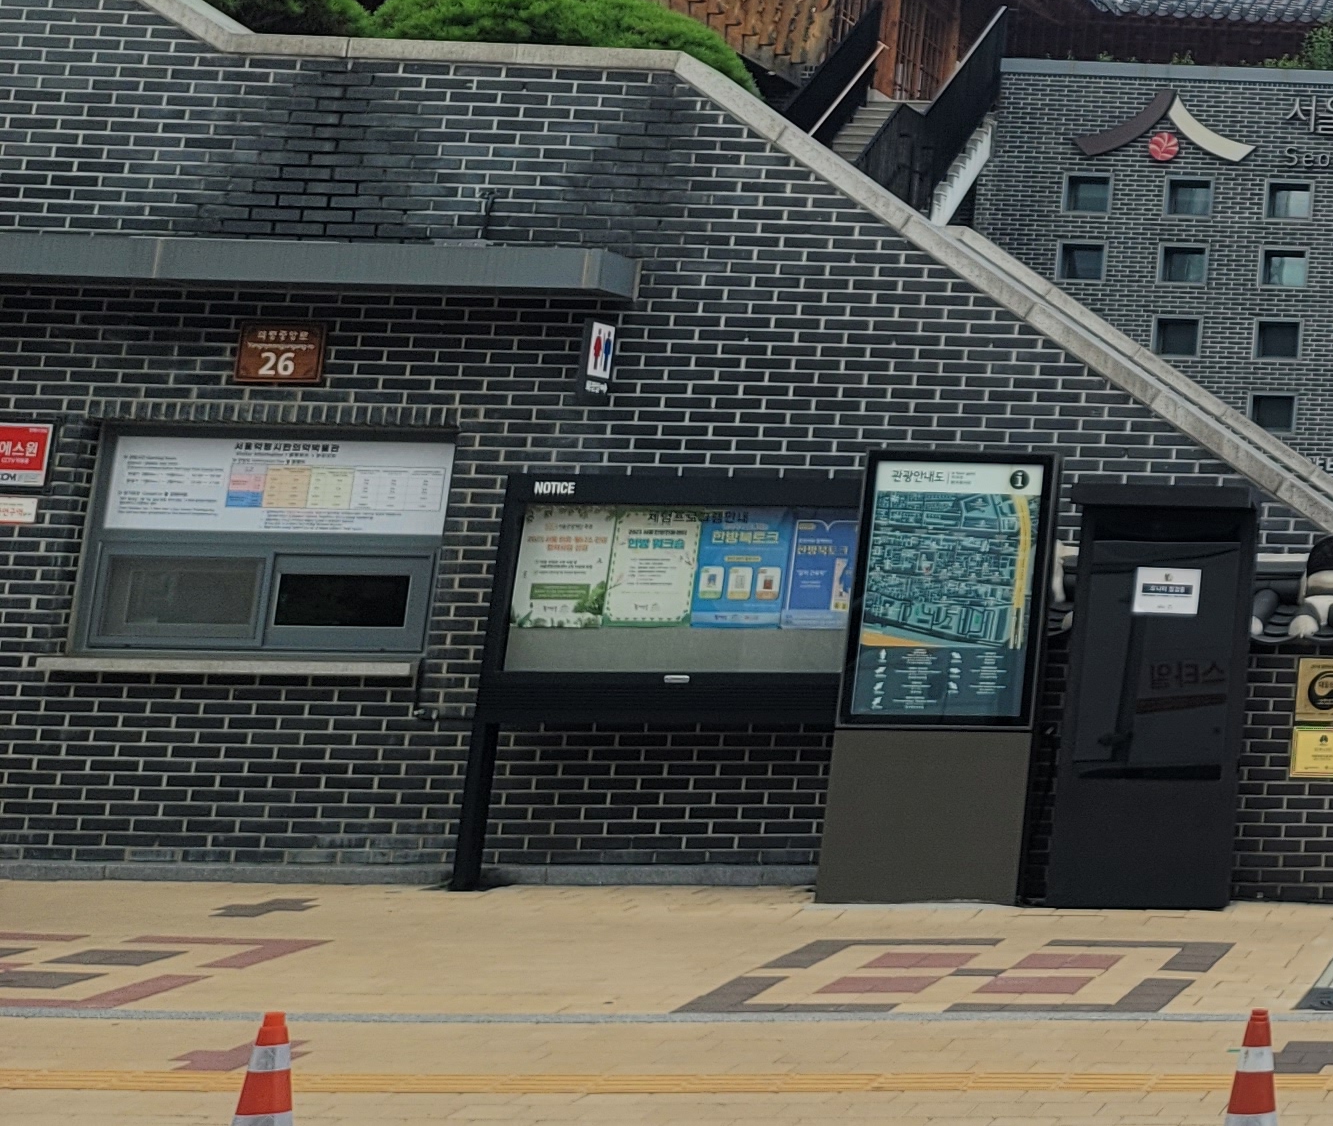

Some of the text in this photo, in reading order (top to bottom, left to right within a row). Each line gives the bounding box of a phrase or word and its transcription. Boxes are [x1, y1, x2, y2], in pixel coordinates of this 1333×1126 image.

[258, 351, 296, 376] 26
[0, 441, 38, 457] 에스원
[892, 470, 945, 482] 관광안내도
[534, 482, 576, 495] NOTICE
